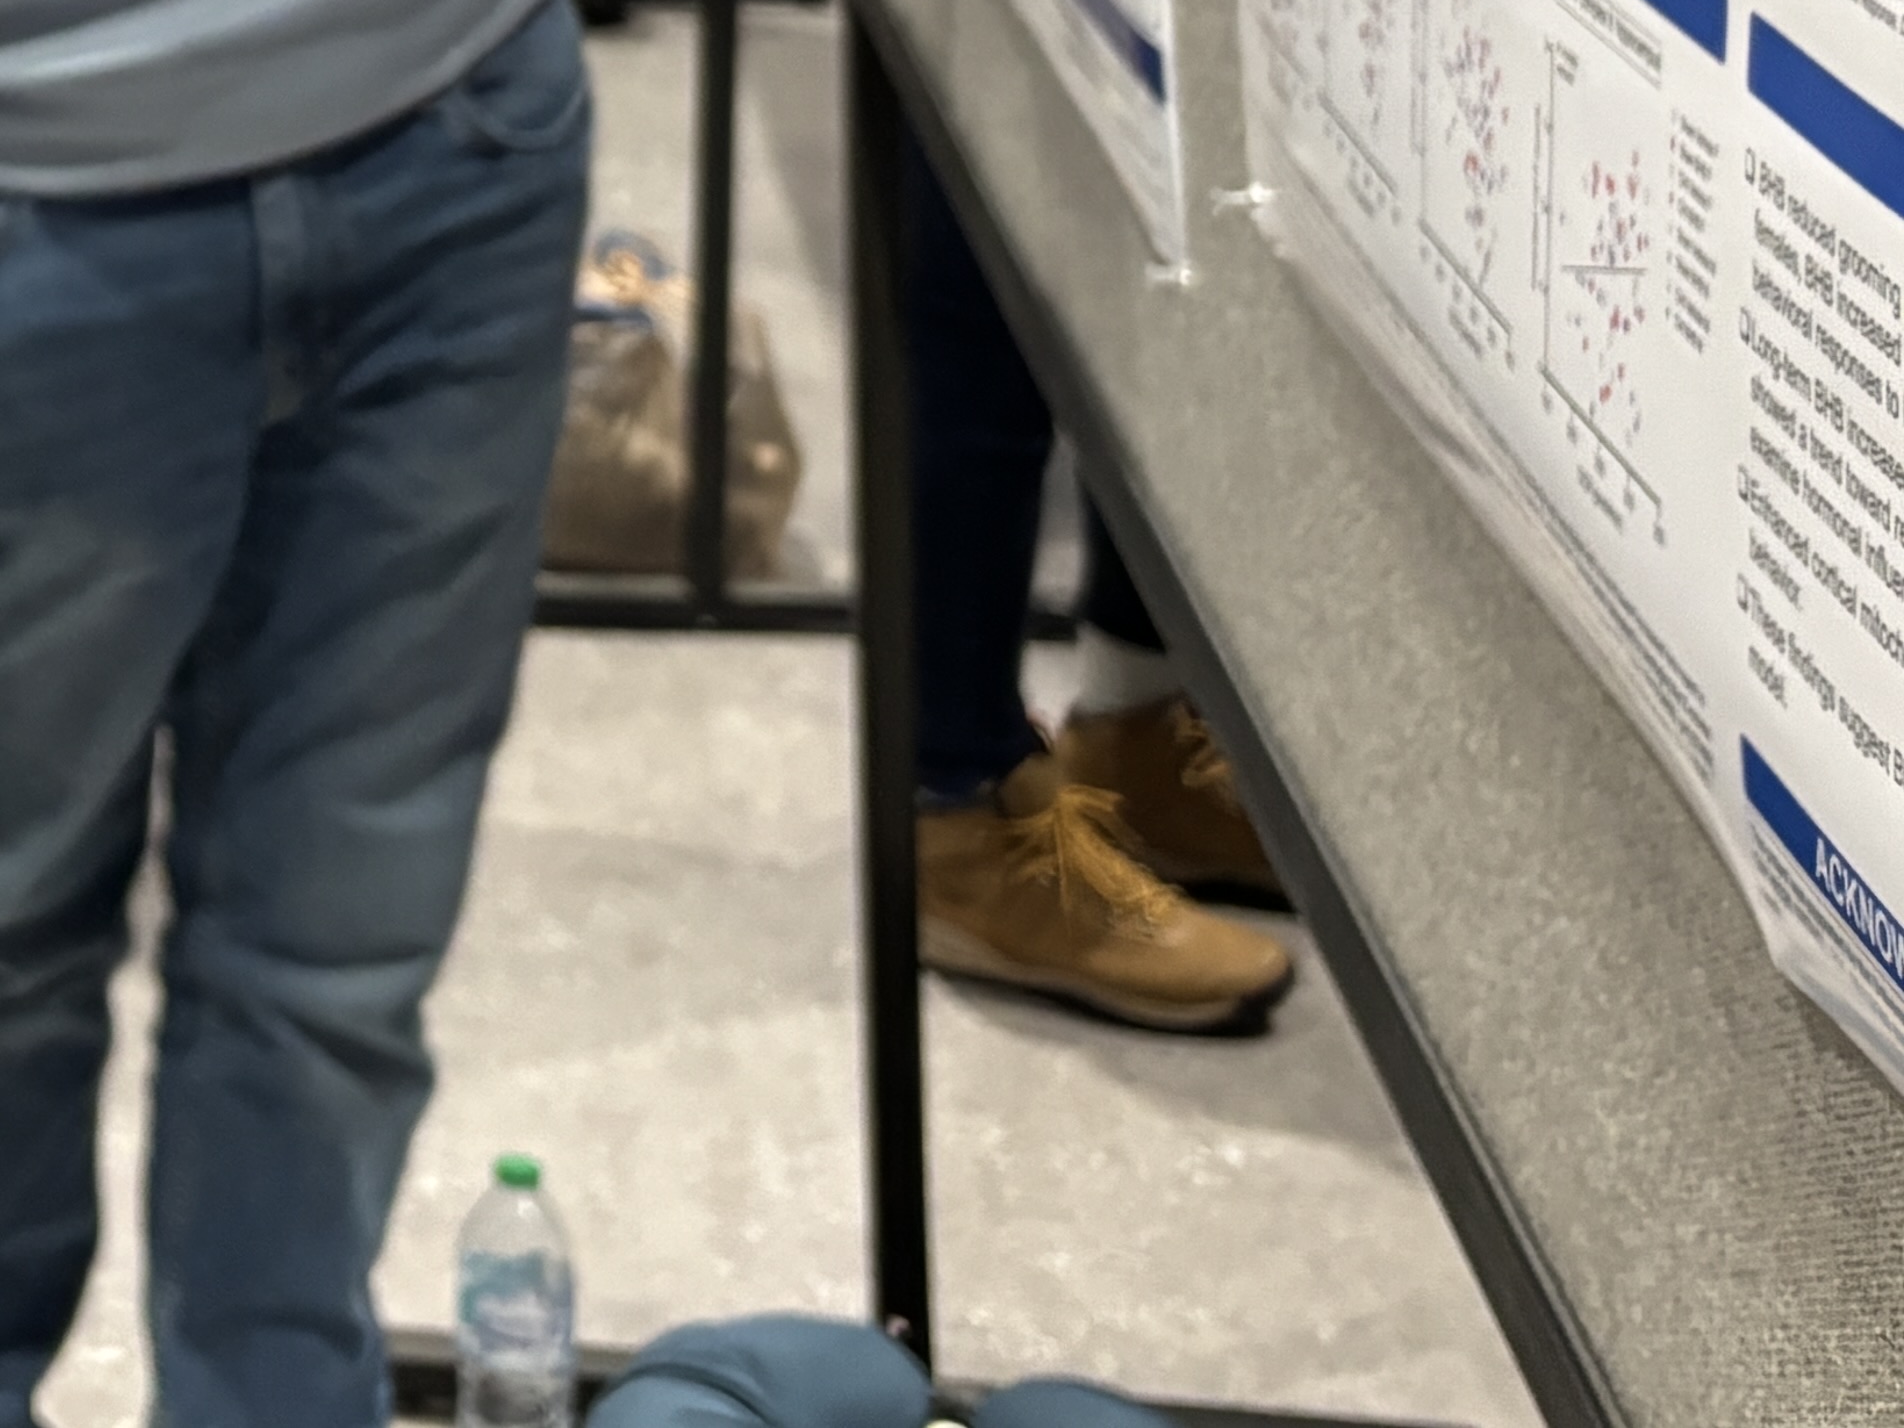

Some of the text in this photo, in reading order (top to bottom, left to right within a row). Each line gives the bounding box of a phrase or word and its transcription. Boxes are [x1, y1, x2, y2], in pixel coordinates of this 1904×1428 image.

[1759, 160, 1785, 212] BHB
[1838, 238, 1901, 321] grooming
[1804, 252, 1834, 309] BHB
[1836, 279, 1902, 368] increased
[1814, 377, 1844, 434] BHB
[1815, 322, 1883, 406] responses
[1885, 379, 1900, 420] to
[1845, 460, 1892, 534] toward
[1811, 550, 1858, 620] cortical
[1838, 694, 1891, 777] suggest
